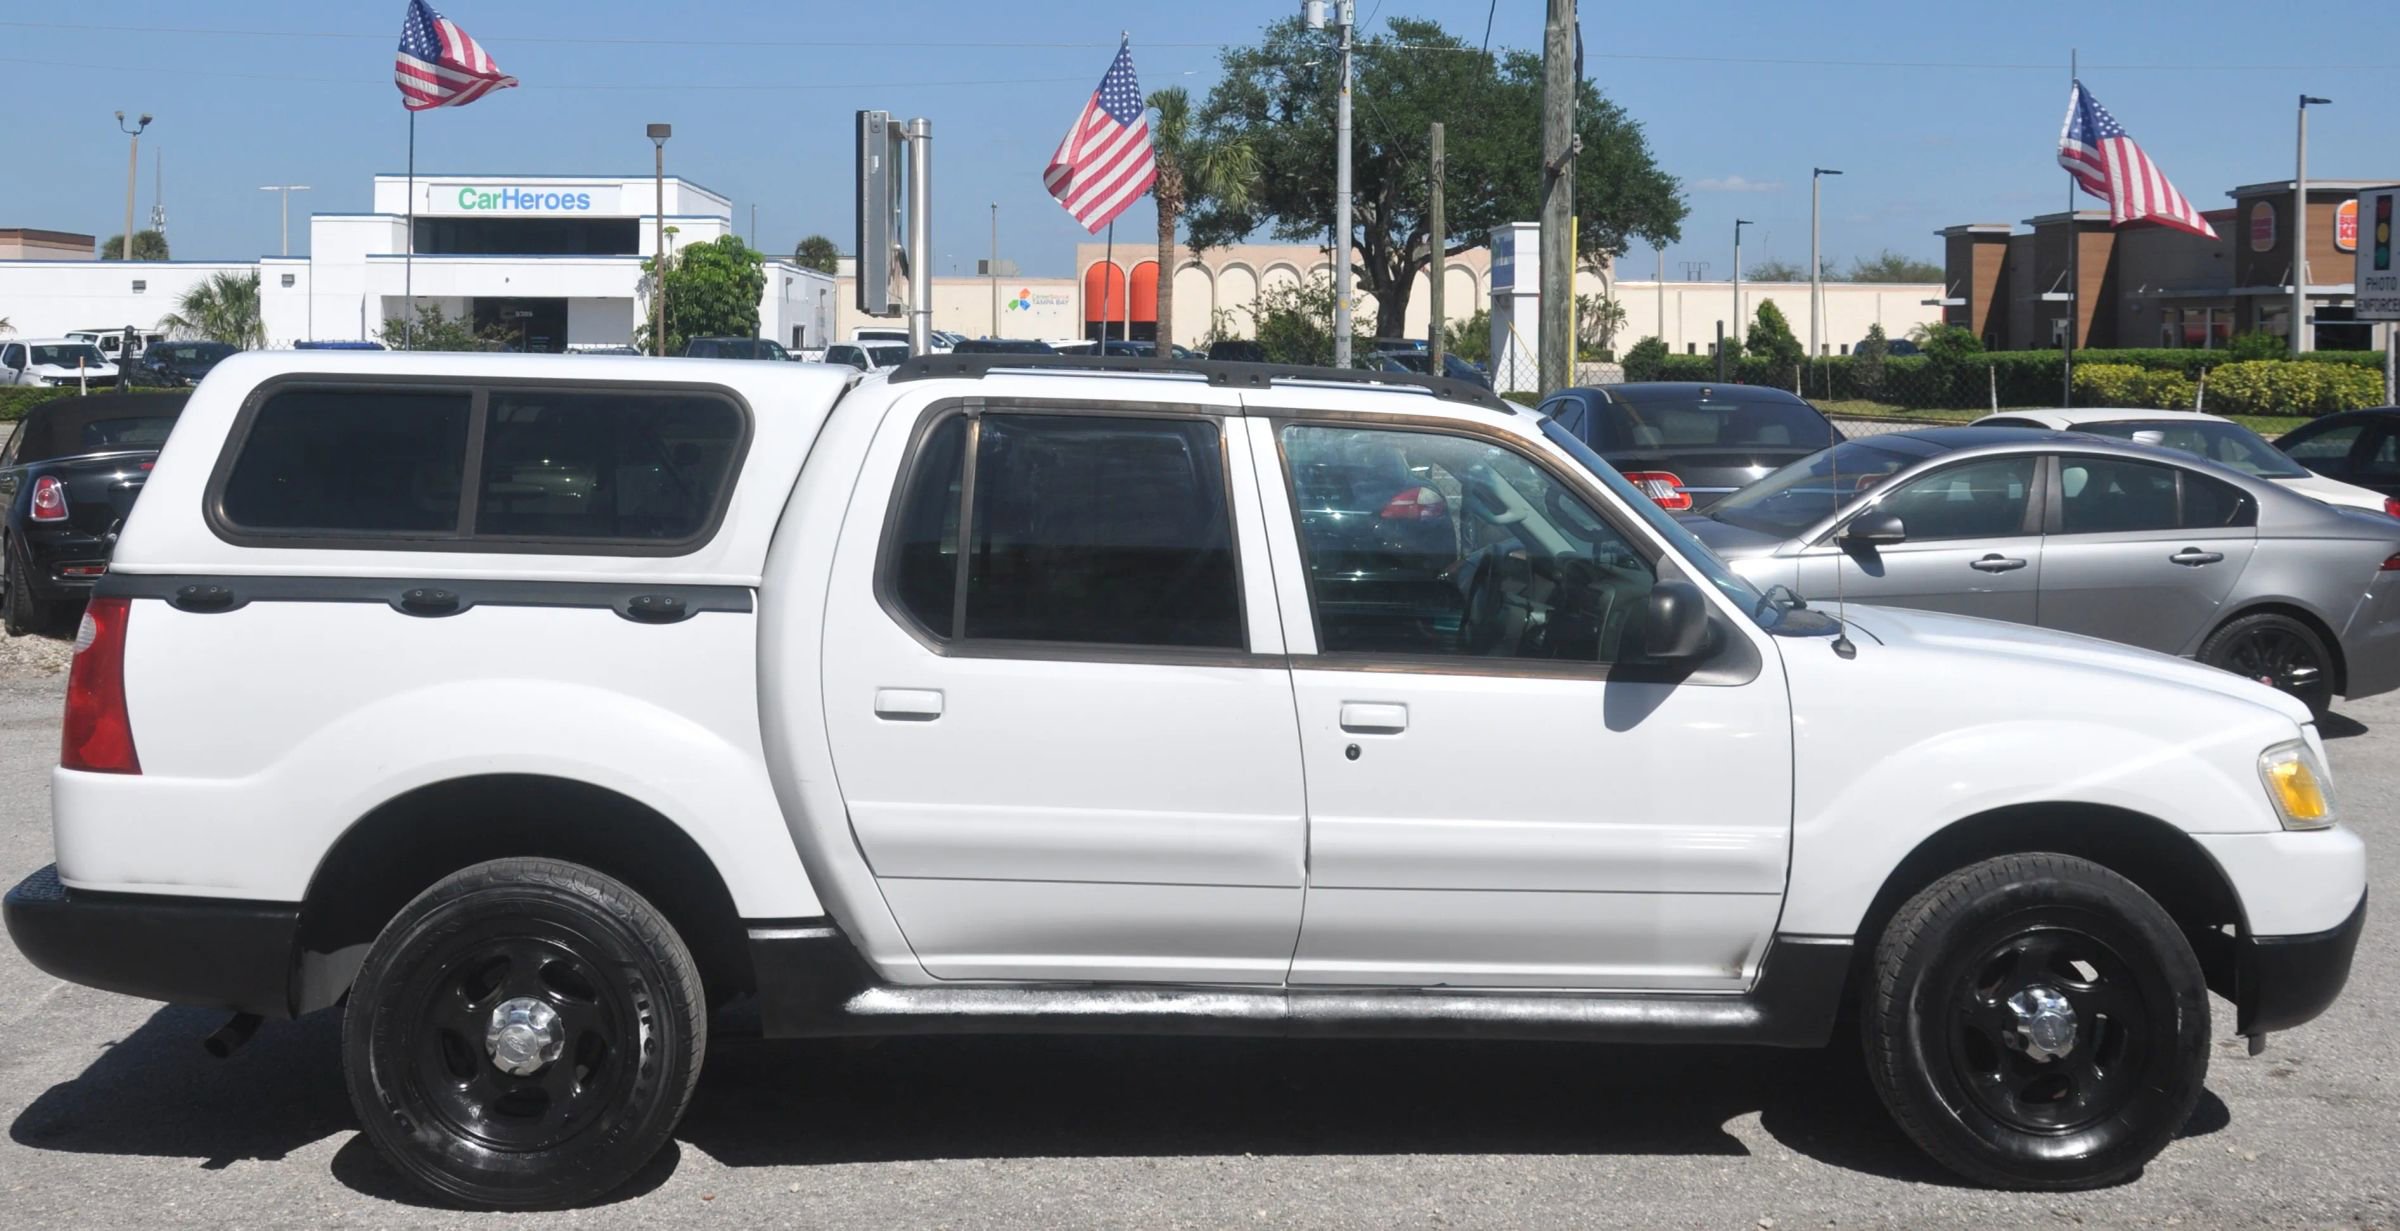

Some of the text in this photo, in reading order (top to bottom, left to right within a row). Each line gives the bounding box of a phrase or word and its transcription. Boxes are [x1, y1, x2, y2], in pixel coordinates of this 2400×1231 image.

[458, 187, 591, 210] CarHeroes
[2340, 225, 2358, 239] KI
[2365, 276, 2398, 291] PHOTO
[2357, 298, 2400, 312] ENFORCE
